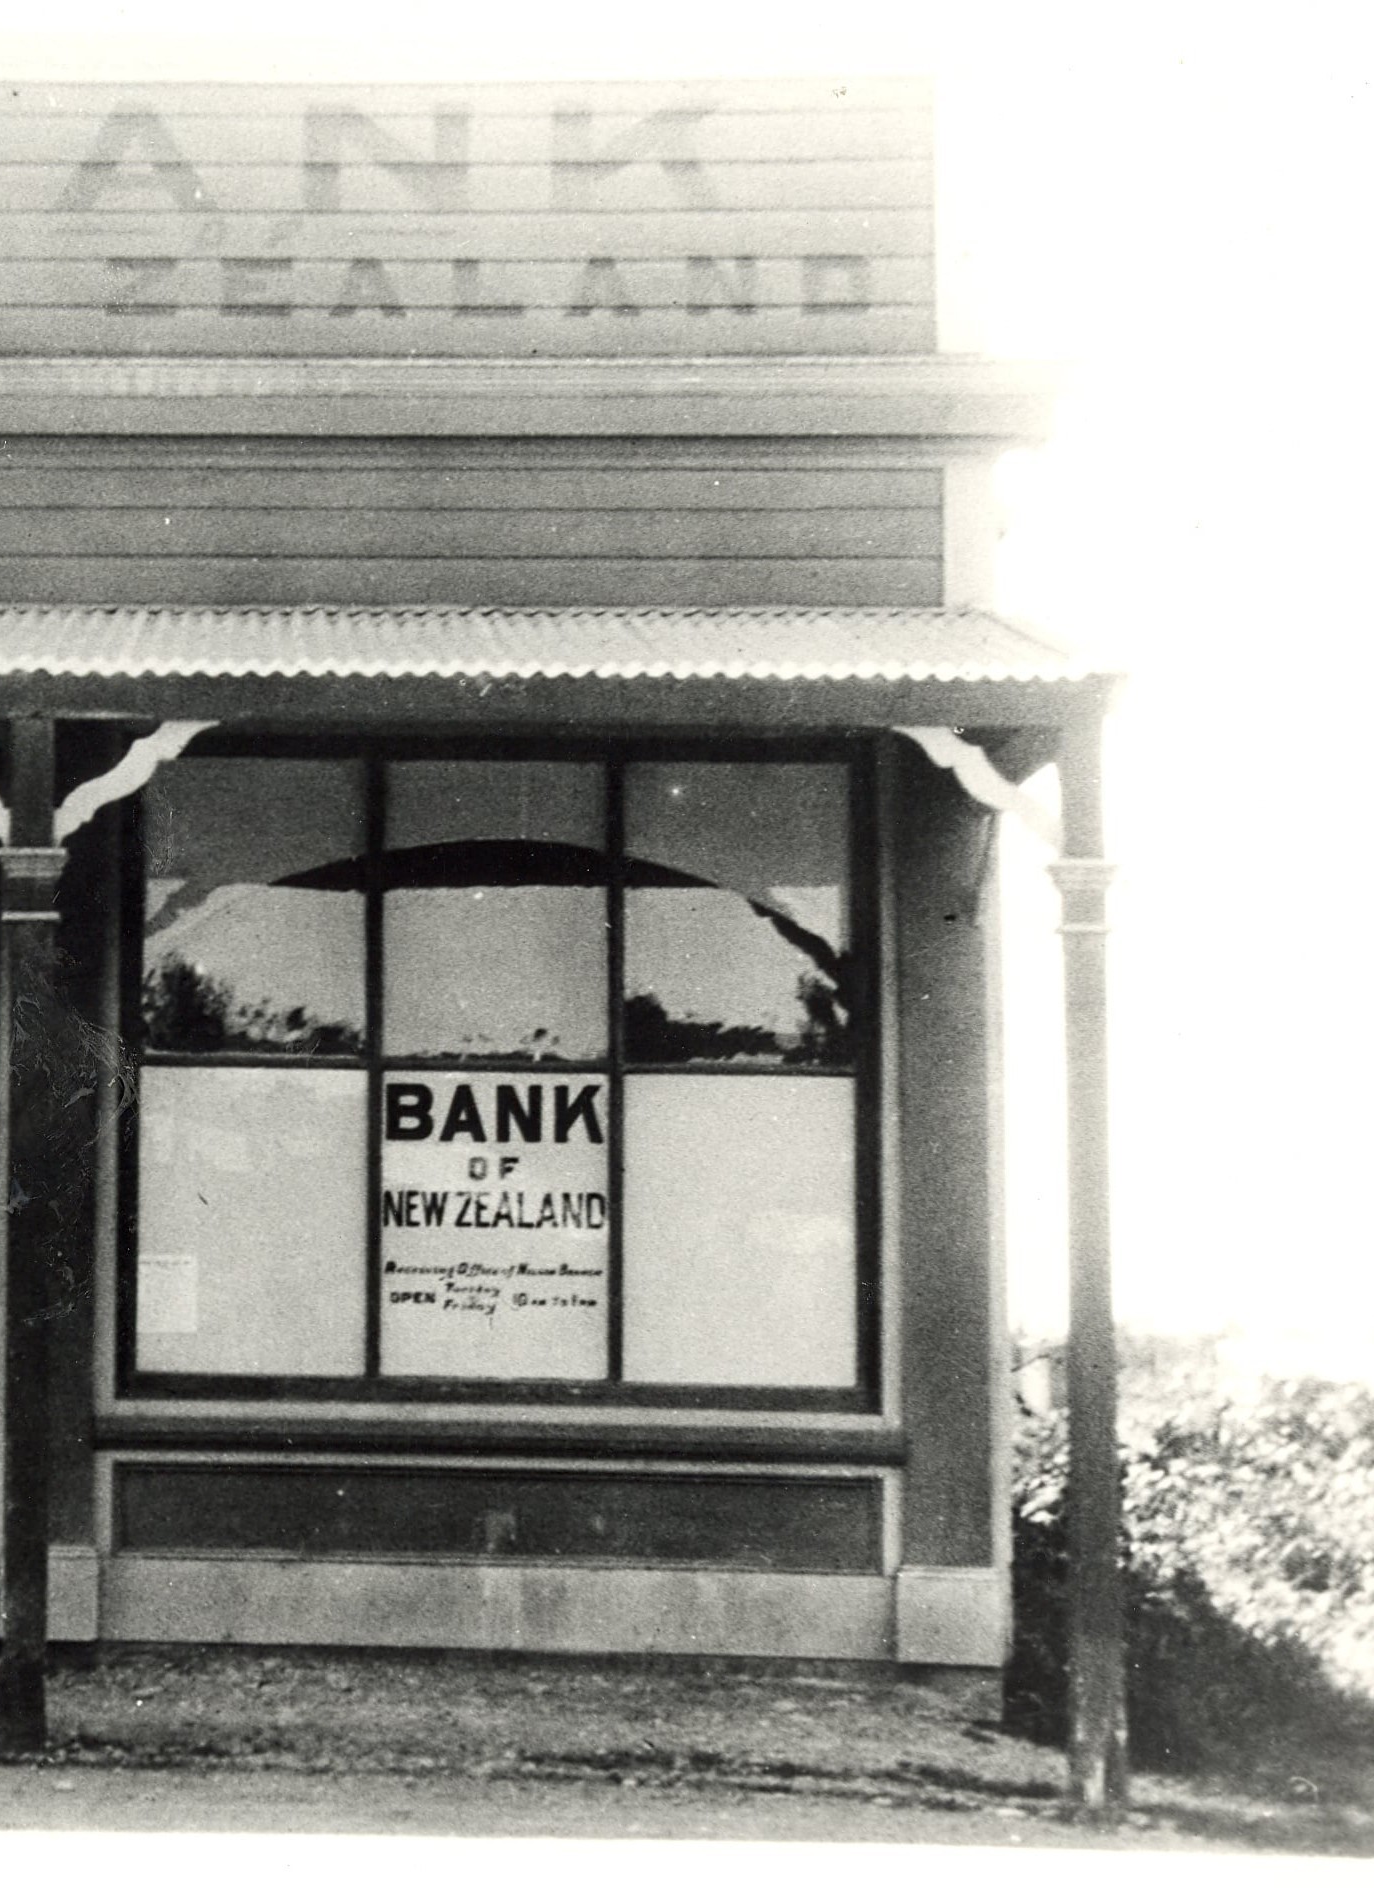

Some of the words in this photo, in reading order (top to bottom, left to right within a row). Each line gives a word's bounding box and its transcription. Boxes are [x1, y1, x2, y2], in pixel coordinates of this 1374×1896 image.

[103, 255, 871, 317] ZEALAND
[385, 1083, 605, 1144] BANK
[468, 1156, 520, 1181] OF
[383, 1190, 448, 1228] NEW
[454, 1190, 607, 1229] ZEALAND
[389, 1291, 437, 1305] OPEN
